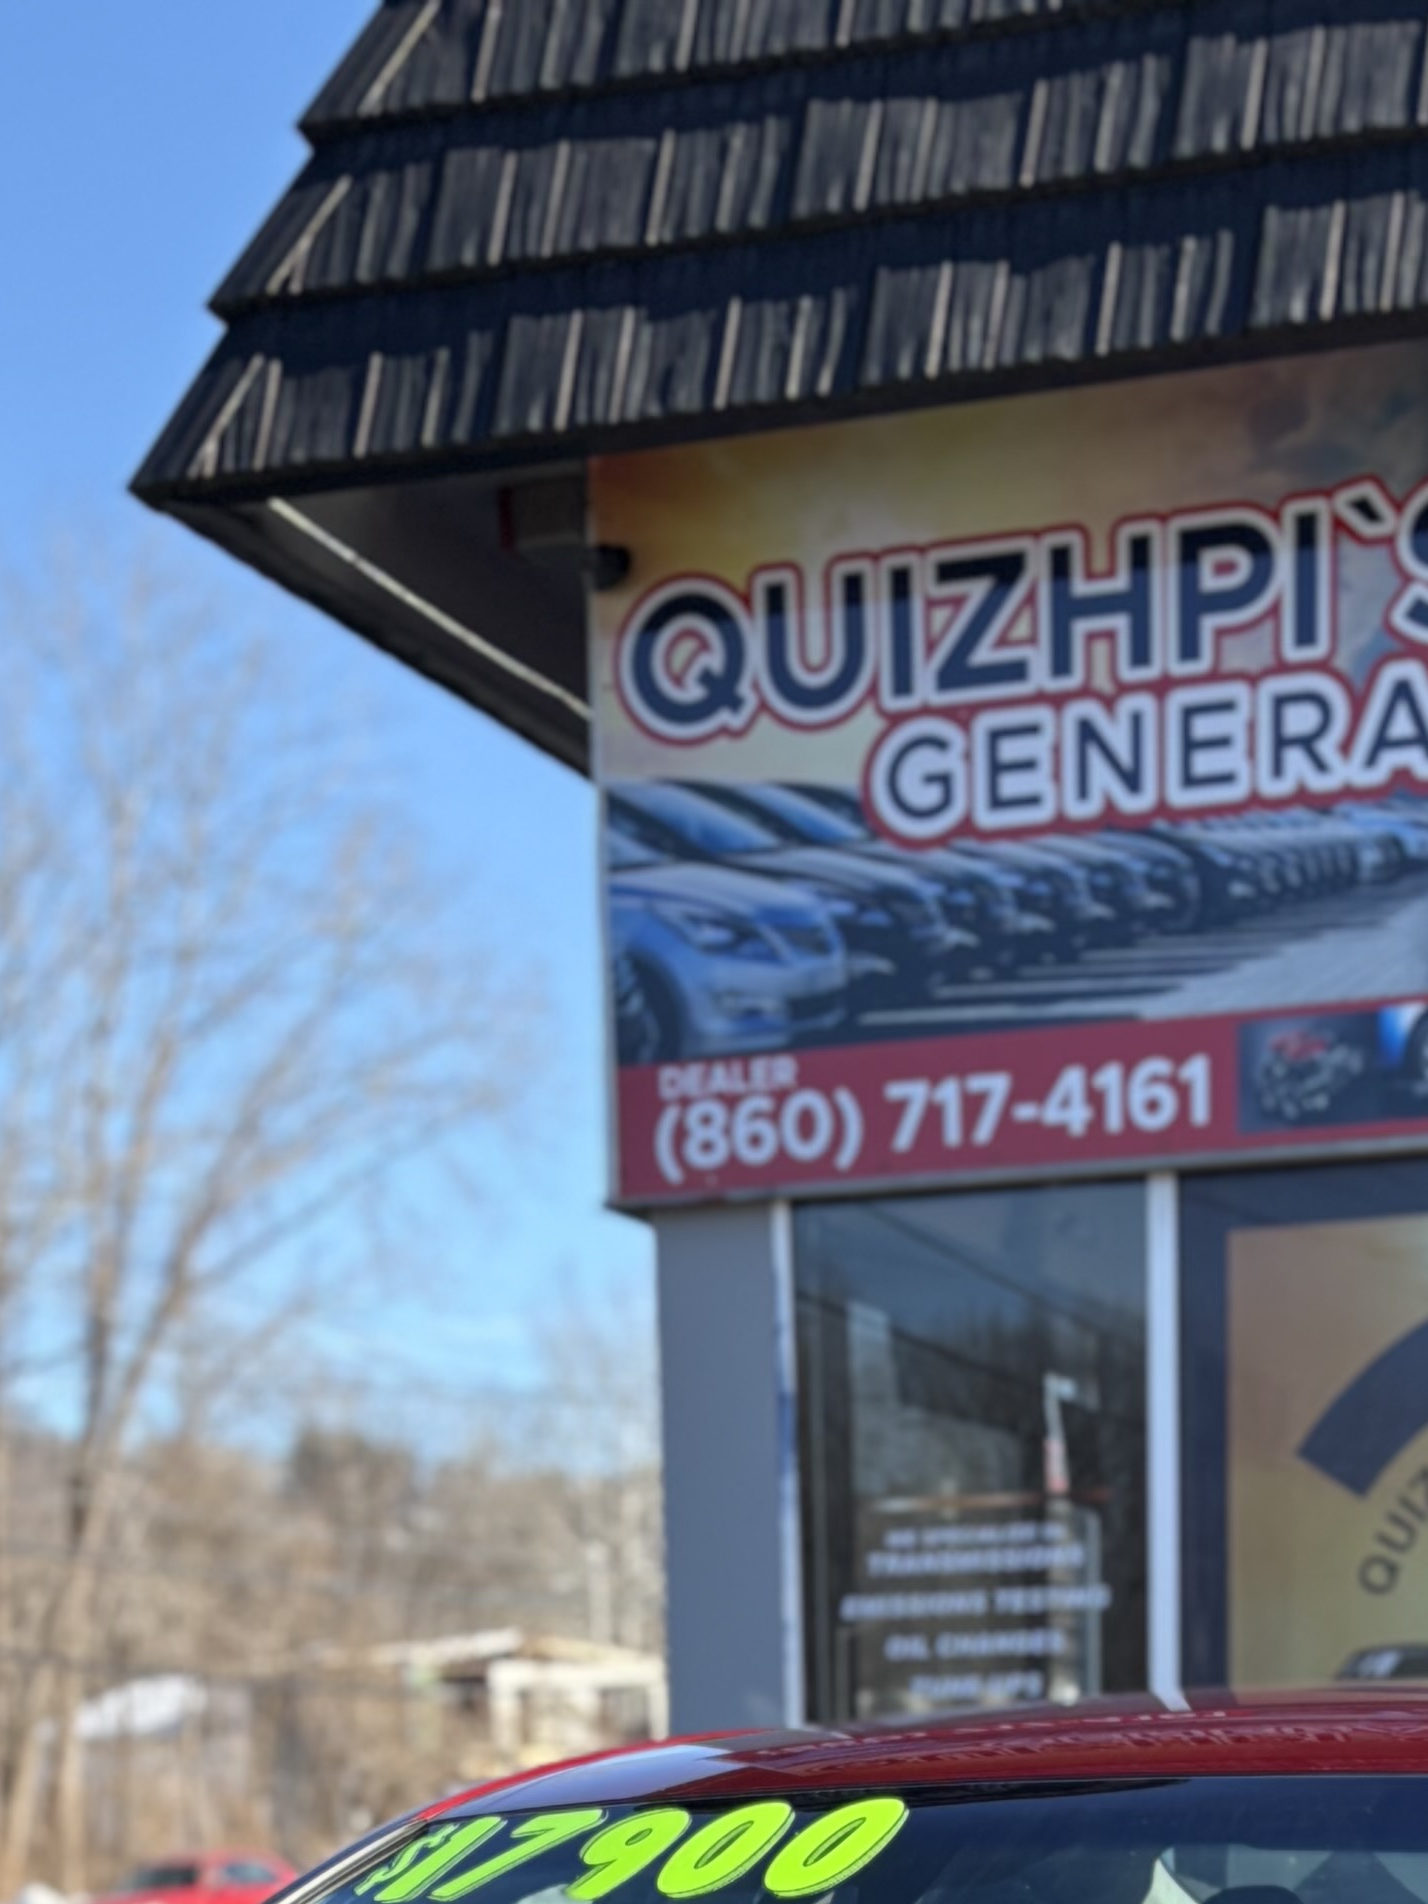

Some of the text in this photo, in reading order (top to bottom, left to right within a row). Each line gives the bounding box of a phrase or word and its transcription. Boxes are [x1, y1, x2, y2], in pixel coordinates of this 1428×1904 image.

[653, 1052, 1212, 1185] (860) 717-4161
[657, 1055, 798, 1099] DEALER
